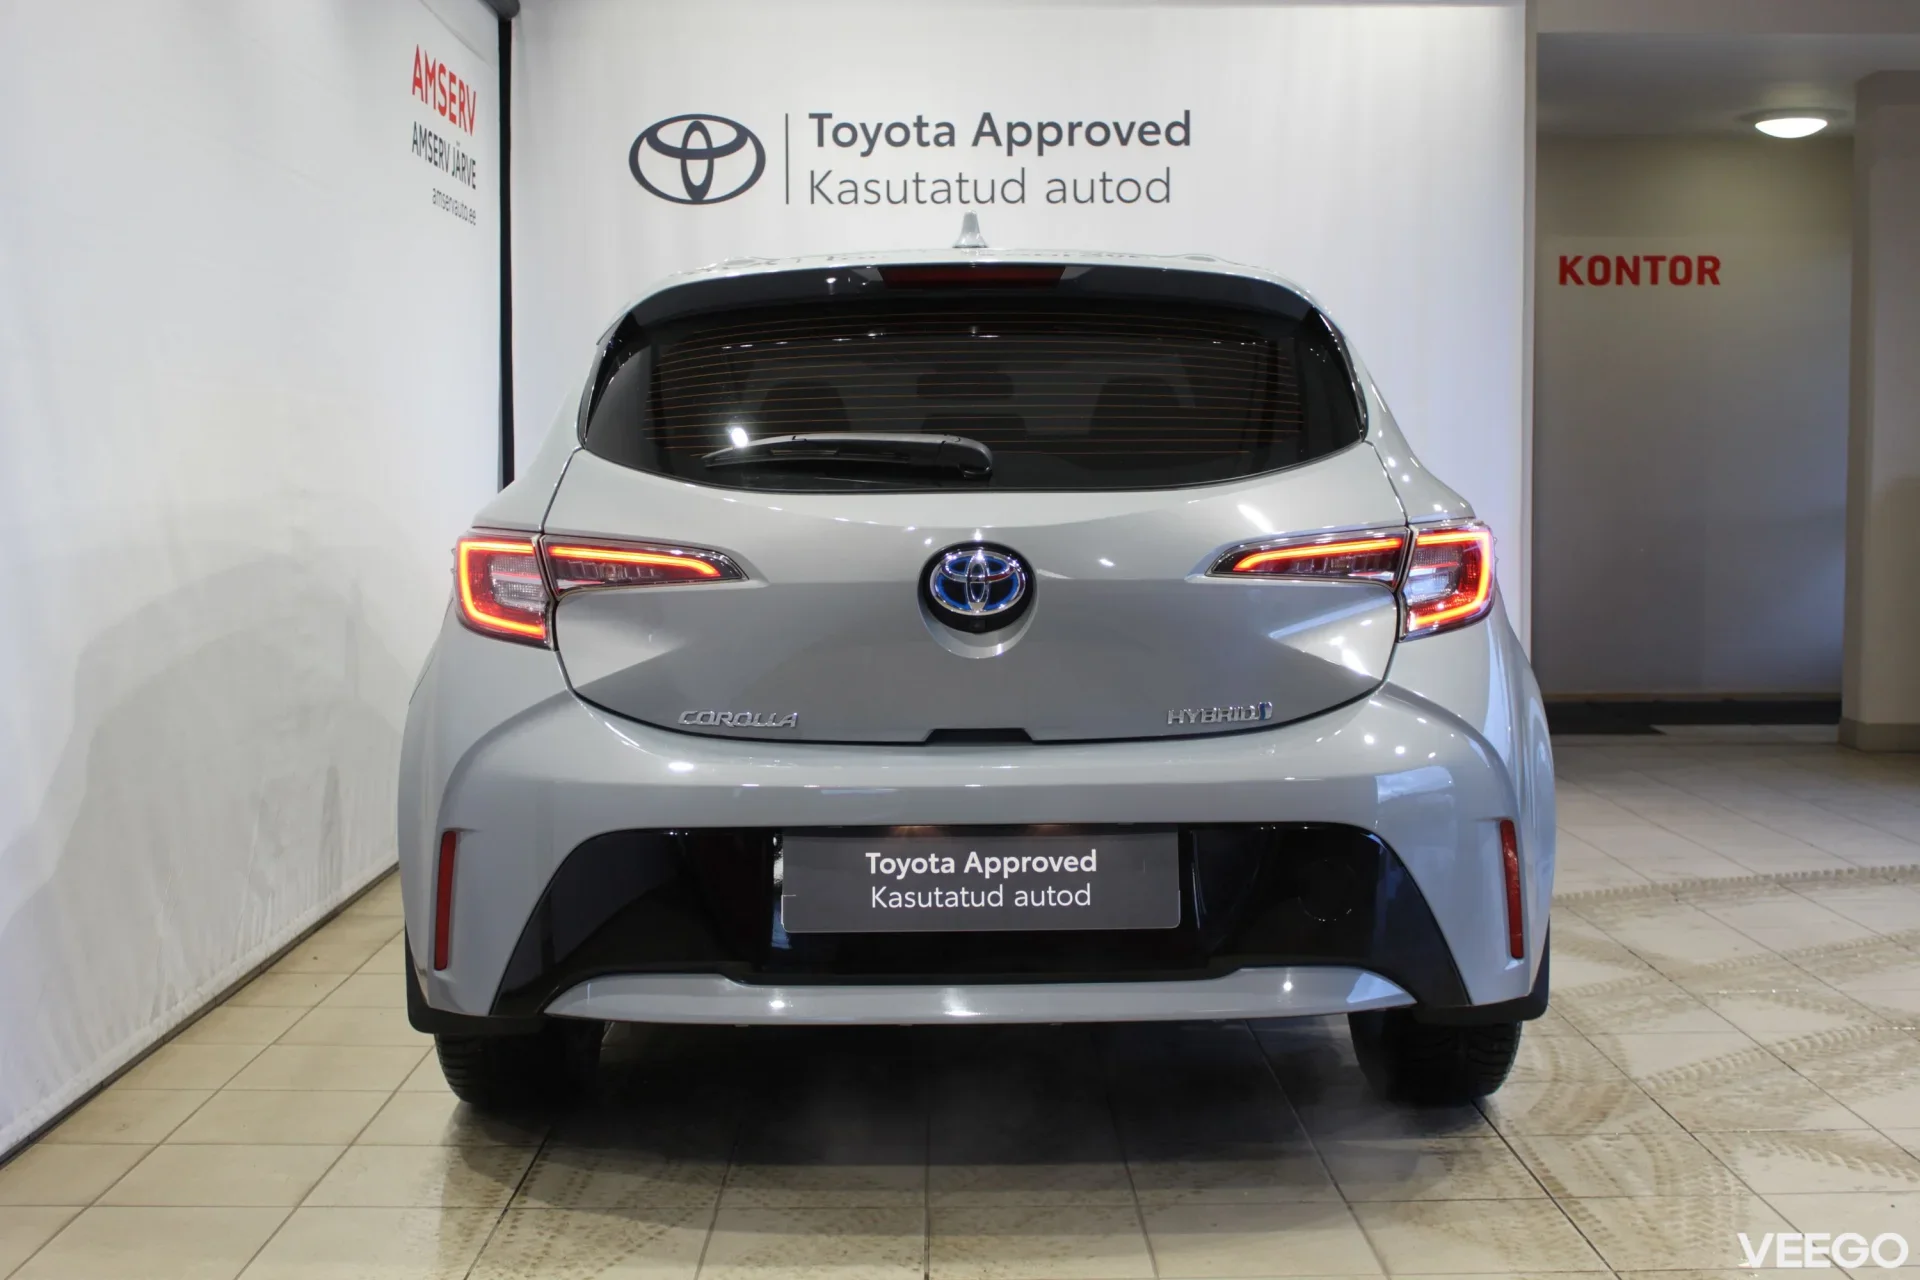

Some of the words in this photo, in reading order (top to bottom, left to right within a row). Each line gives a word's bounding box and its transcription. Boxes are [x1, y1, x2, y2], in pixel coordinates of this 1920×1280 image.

[412, 44, 476, 136] AMSERV
[808, 111, 956, 157] Toyota
[971, 109, 1191, 156] Approved
[412, 121, 451, 173] AMSERV
[451, 141, 476, 190] JÄRVE
[809, 167, 1026, 205] Kasutatud
[1045, 167, 1171, 205] autod
[432, 188, 476, 226] amservauto.ee
[1559, 255, 1721, 286] KONTOR
[678, 710, 798, 728] COROLLA
[1167, 705, 1257, 725] HYBRID
[865, 852, 956, 880] Toyota
[964, 849, 1097, 878] Approved
[871, 885, 1004, 908] Kasutatud
[1014, 883, 1091, 907] autod
